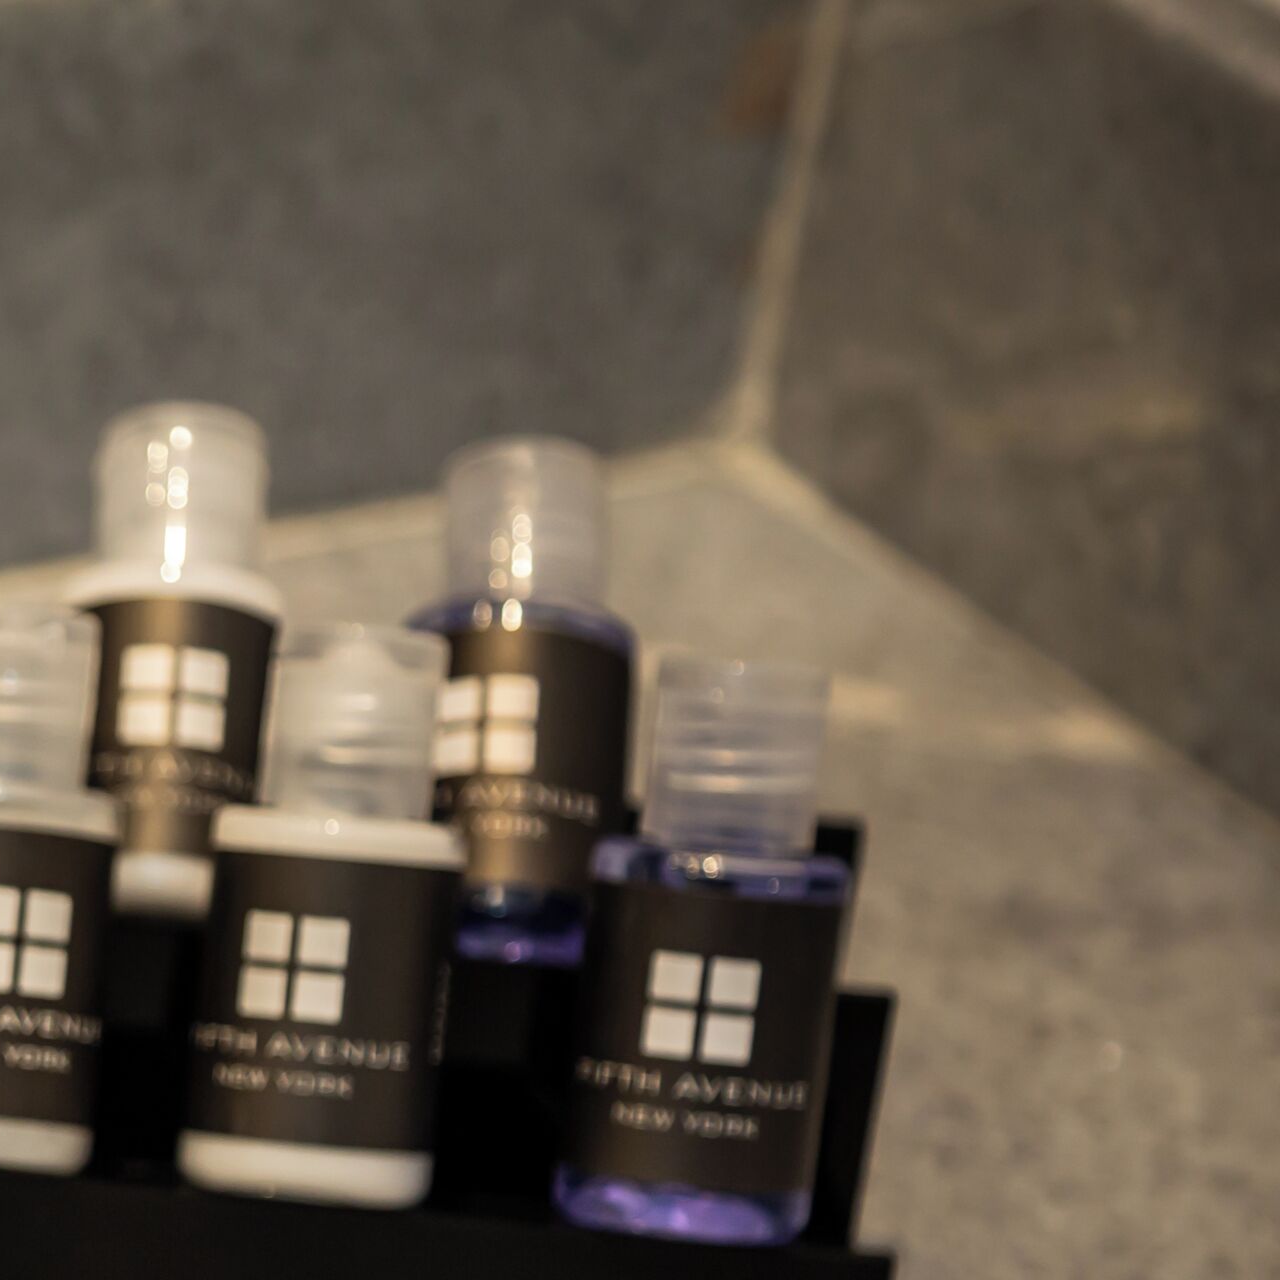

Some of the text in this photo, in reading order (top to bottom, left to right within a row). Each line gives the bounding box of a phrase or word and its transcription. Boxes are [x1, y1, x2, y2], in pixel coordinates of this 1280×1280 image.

[264, 1031, 411, 1072] AVENUE
[671, 1071, 809, 1111] AVENUE
[610, 1100, 675, 1132] NEW
